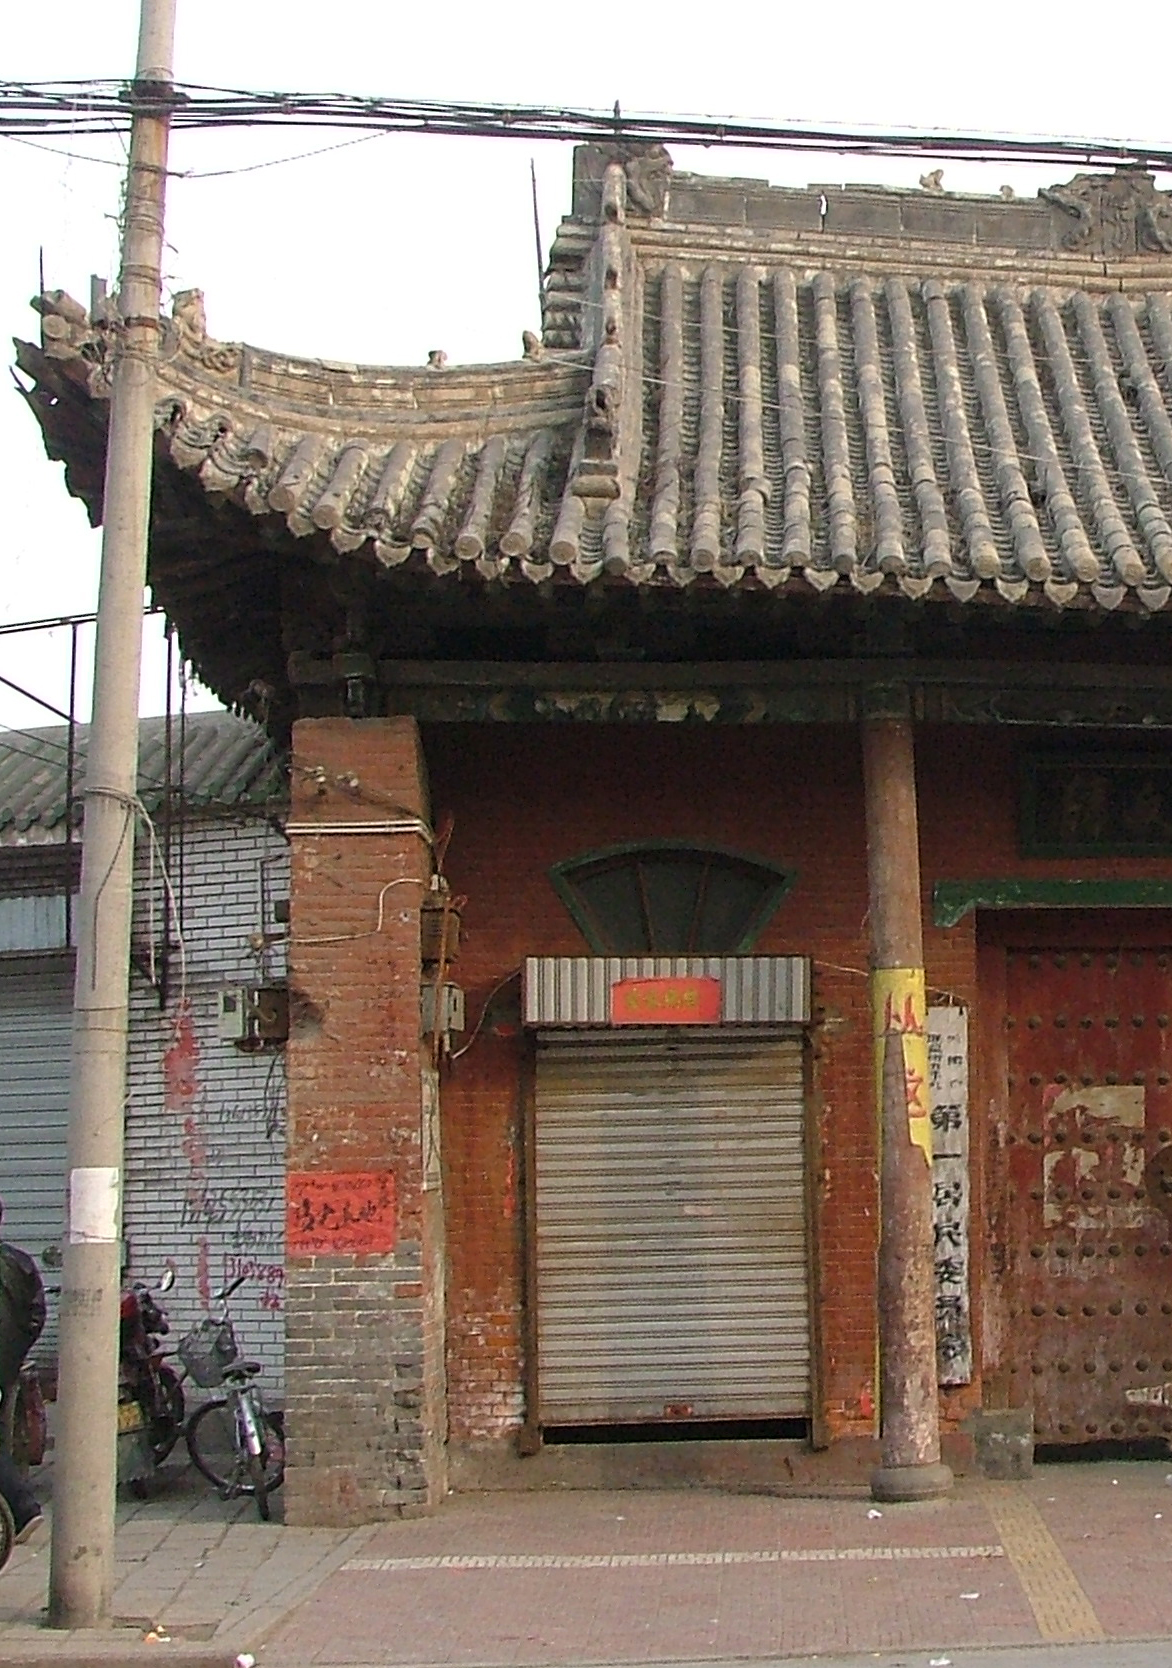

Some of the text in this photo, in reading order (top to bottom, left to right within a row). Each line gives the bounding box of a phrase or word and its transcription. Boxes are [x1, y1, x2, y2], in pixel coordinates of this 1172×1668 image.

[930, 1104, 968, 1361] 第一居民委员会
